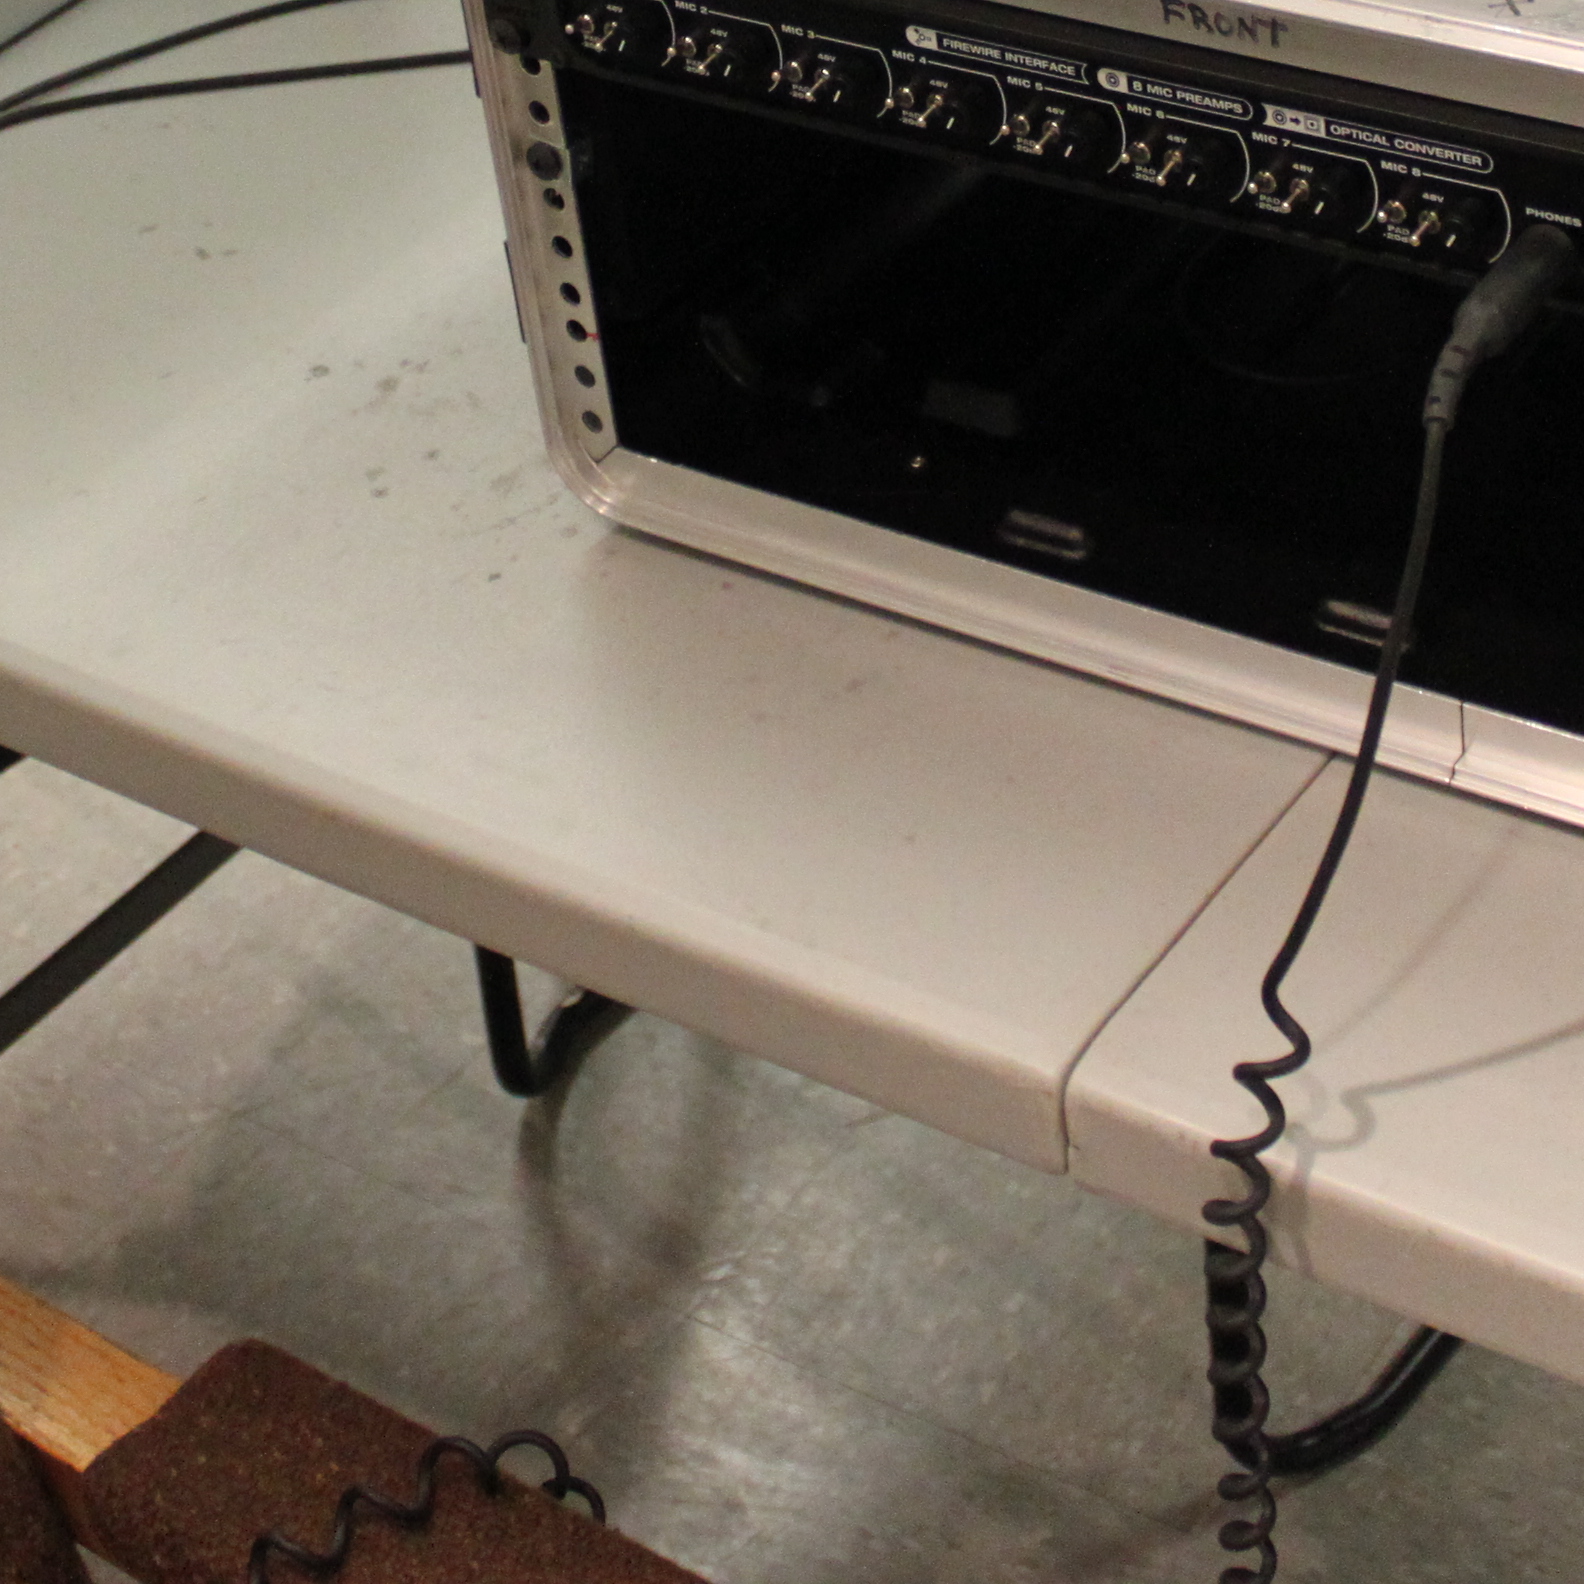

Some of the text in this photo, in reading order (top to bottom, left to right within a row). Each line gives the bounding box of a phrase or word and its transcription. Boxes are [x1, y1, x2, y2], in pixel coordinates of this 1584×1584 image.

[674, 0, 697, 13] MIC
[781, 24, 804, 36] MIC
[891, 49, 915, 63] MIC
[942, 37, 1077, 76] FIREWIRE INTERFACE
[1006, 75, 1032, 89] MIC
[1131, 80, 1244, 115] 8 MIC PREAMPS
[1126, 102, 1153, 116] MIC
[1250, 130, 1279, 146] MIC
[1329, 124, 1483, 168] OPTICAL CONVERTER
[1292, 163, 1315, 174] 48V
[1379, 159, 1408, 175] MIC
[1259, 194, 1282, 205] PAD
[1421, 192, 1445, 204] 48V
[1525, 206, 1583, 228] PHONES
[1387, 224, 1411, 236] PAD
